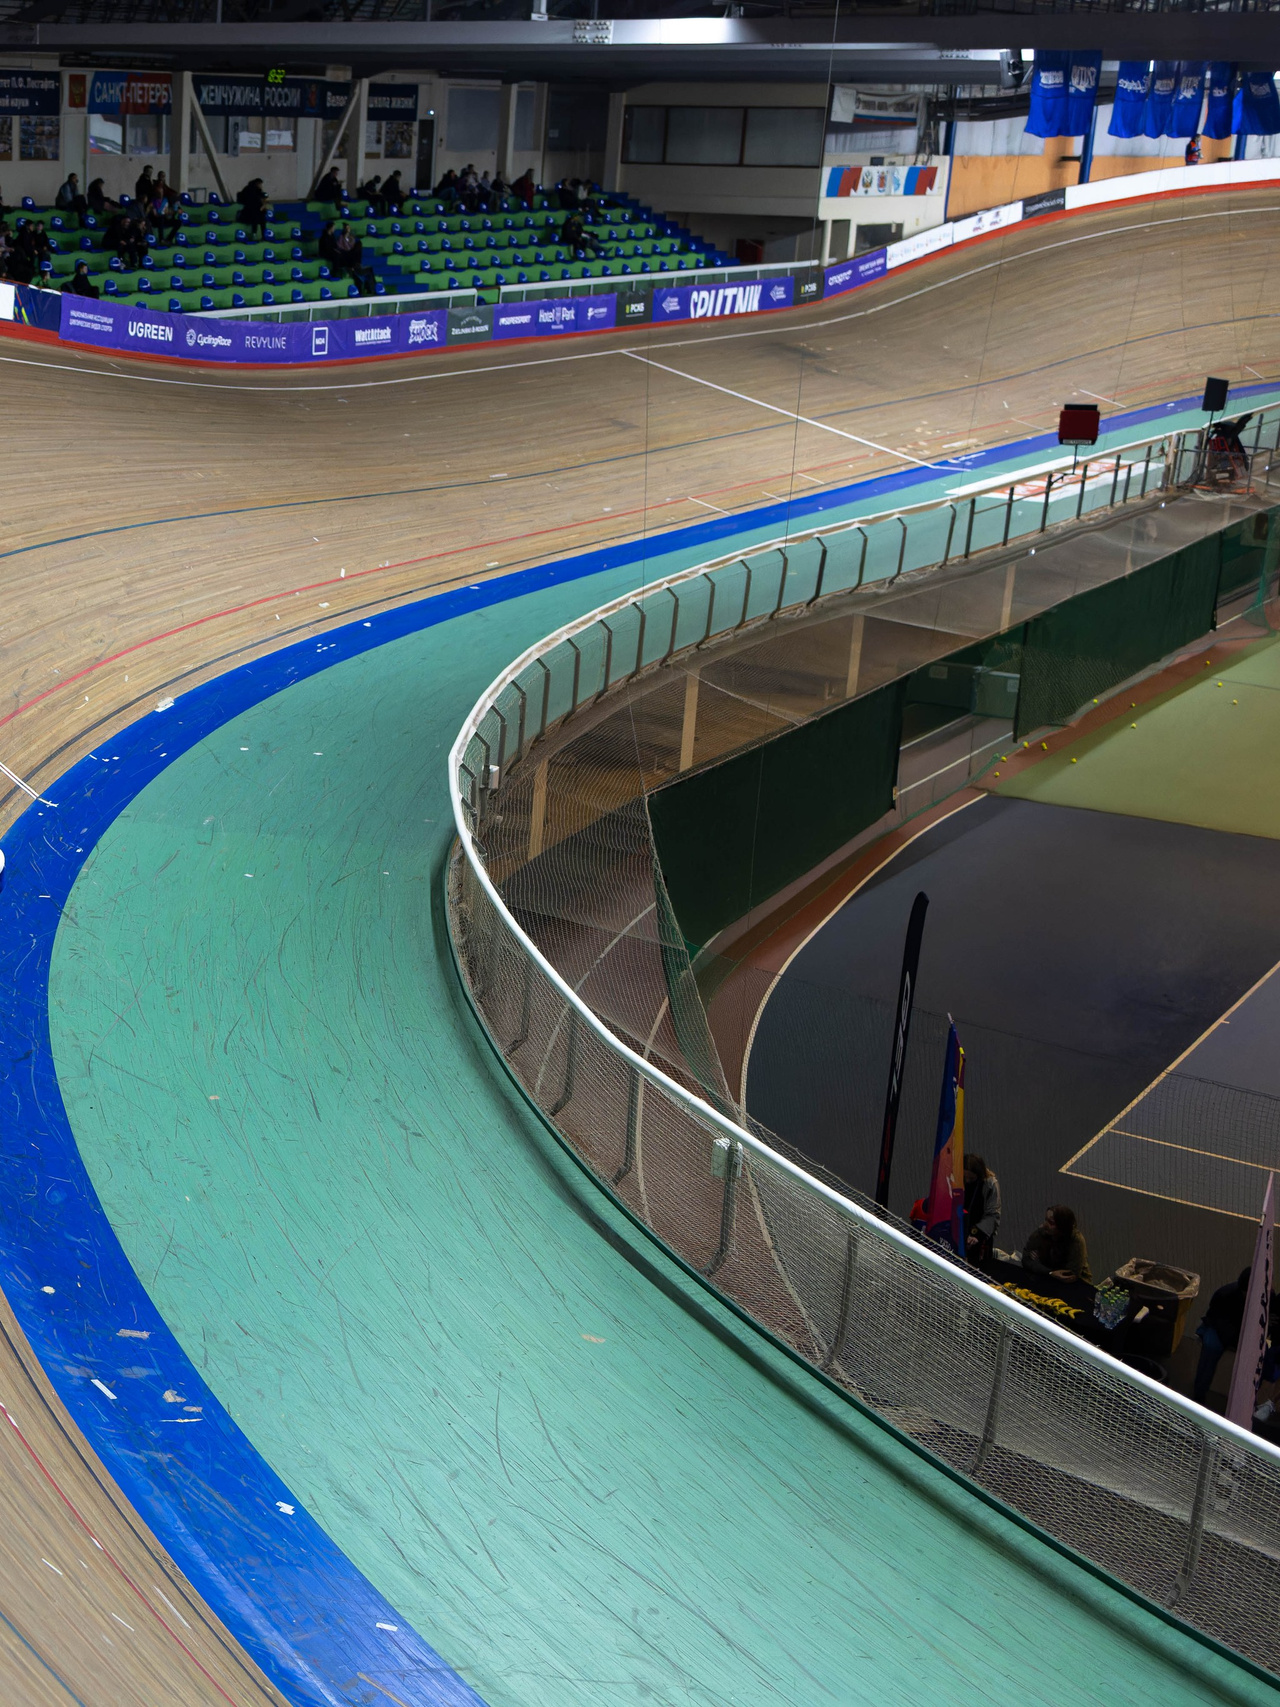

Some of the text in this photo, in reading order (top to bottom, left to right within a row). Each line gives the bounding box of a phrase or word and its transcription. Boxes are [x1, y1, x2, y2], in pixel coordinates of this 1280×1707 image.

[199, 84, 301, 108] ЖЕМЧУЖИНА РОССИИ
[538, 308, 555, 323] Hotel
[561, 306, 575, 321] Park
[128, 320, 173, 342] UGREEN
[354, 326, 392, 343] WattAttack
[197, 333, 232, 347] CyclingRace
[244, 335, 287, 349] REVYLINE
